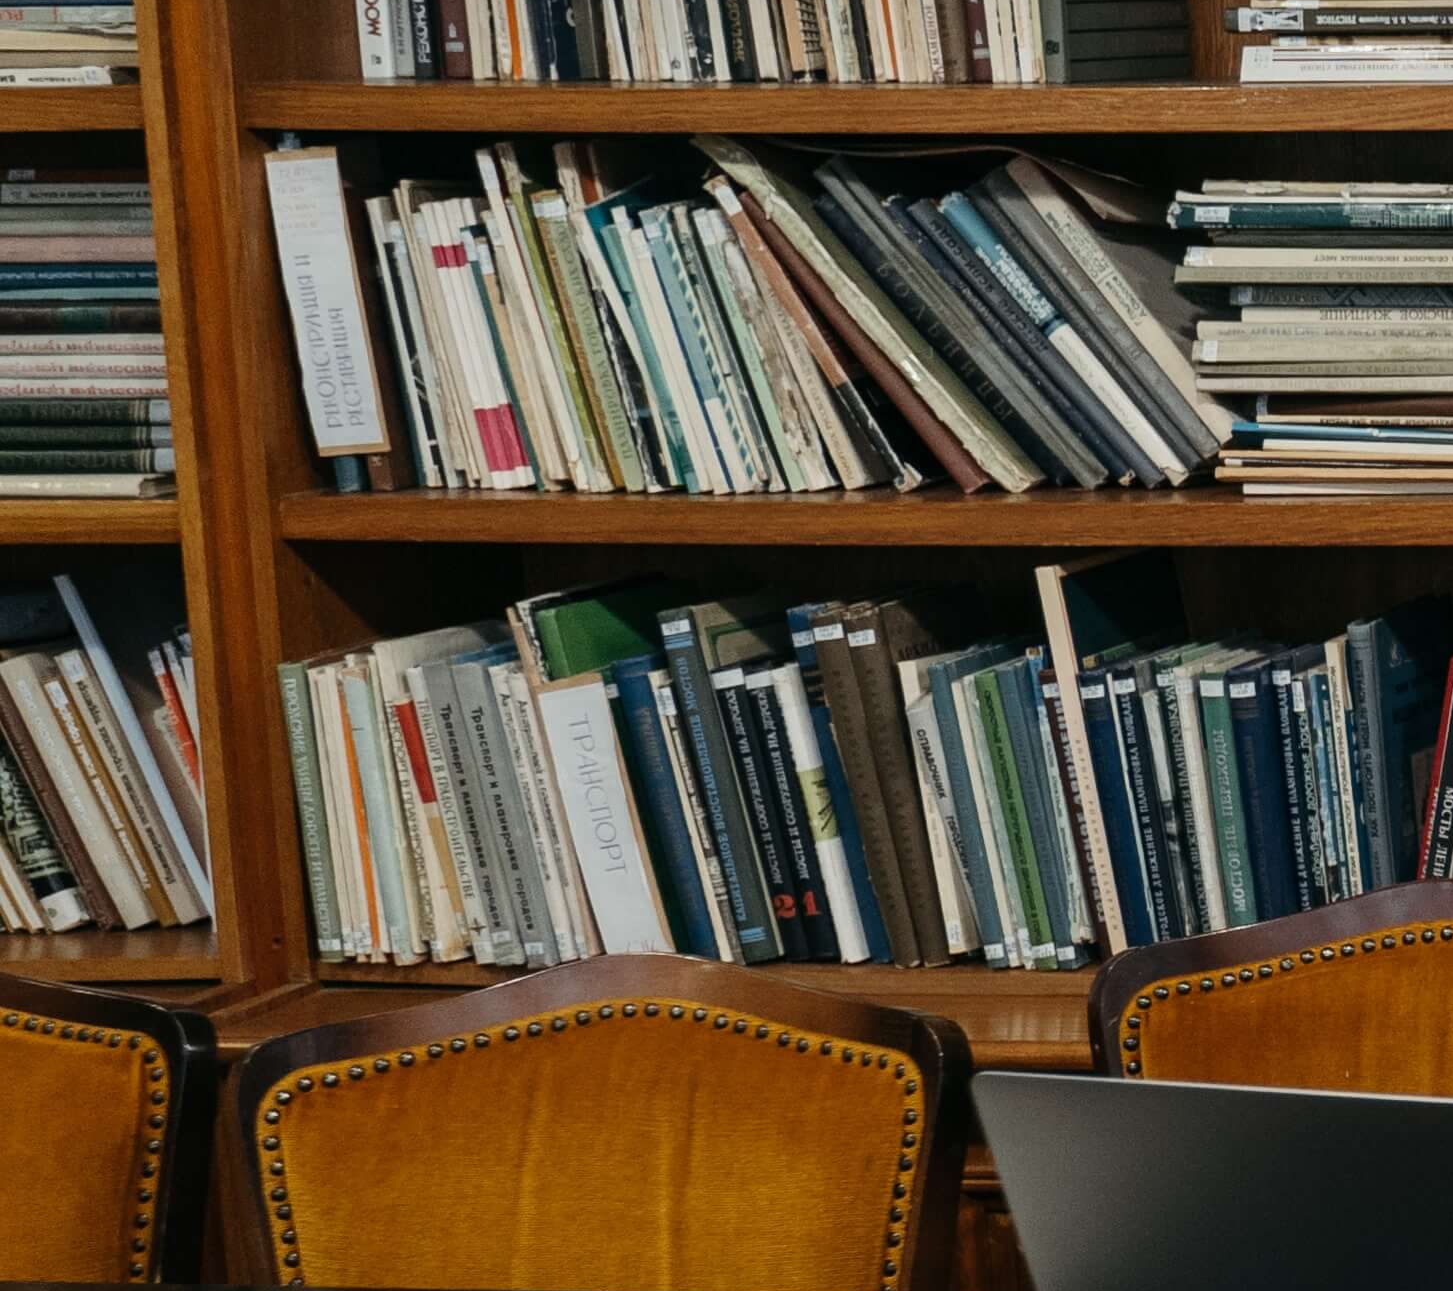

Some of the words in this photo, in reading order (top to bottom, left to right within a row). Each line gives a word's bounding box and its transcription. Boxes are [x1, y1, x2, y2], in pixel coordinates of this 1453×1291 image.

[1318, 307, 1391, 320] ЖИЛИЩЕ
[674, 654, 697, 711] МОСТОВ
[724, 687, 746, 737] ДОРОГАХ
[737, 736, 751, 754] НА
[766, 731, 779, 748] НА
[914, 727, 949, 801] СПРАВОЧНИК
[565, 710, 630, 879] ТРАНСПОРТ
[742, 754, 770, 831] СООРУЖЕНИЯ
[770, 750, 798, 825] СООРУЖЕНИЯ
[1129, 746, 1150, 812] ПЛАНИРОВКА
[1209, 727, 1236, 817] ПЕРЕХОДЫ
[438, 705, 466, 776] Транспорт
[459, 790, 488, 870] планировка
[479, 873, 502, 929] городов
[470, 706, 498, 779] Транспорт
[491, 792, 520, 872] планировка
[511, 875, 535, 931] городов
[763, 843, 784, 885] МОСТЫ
[790, 837, 810, 880] МОСТЫ
[1223, 822, 1247, 912] МОСТОВЫЕ
[772, 892, 797, 919] 2
[801, 889, 822, 917] 1
